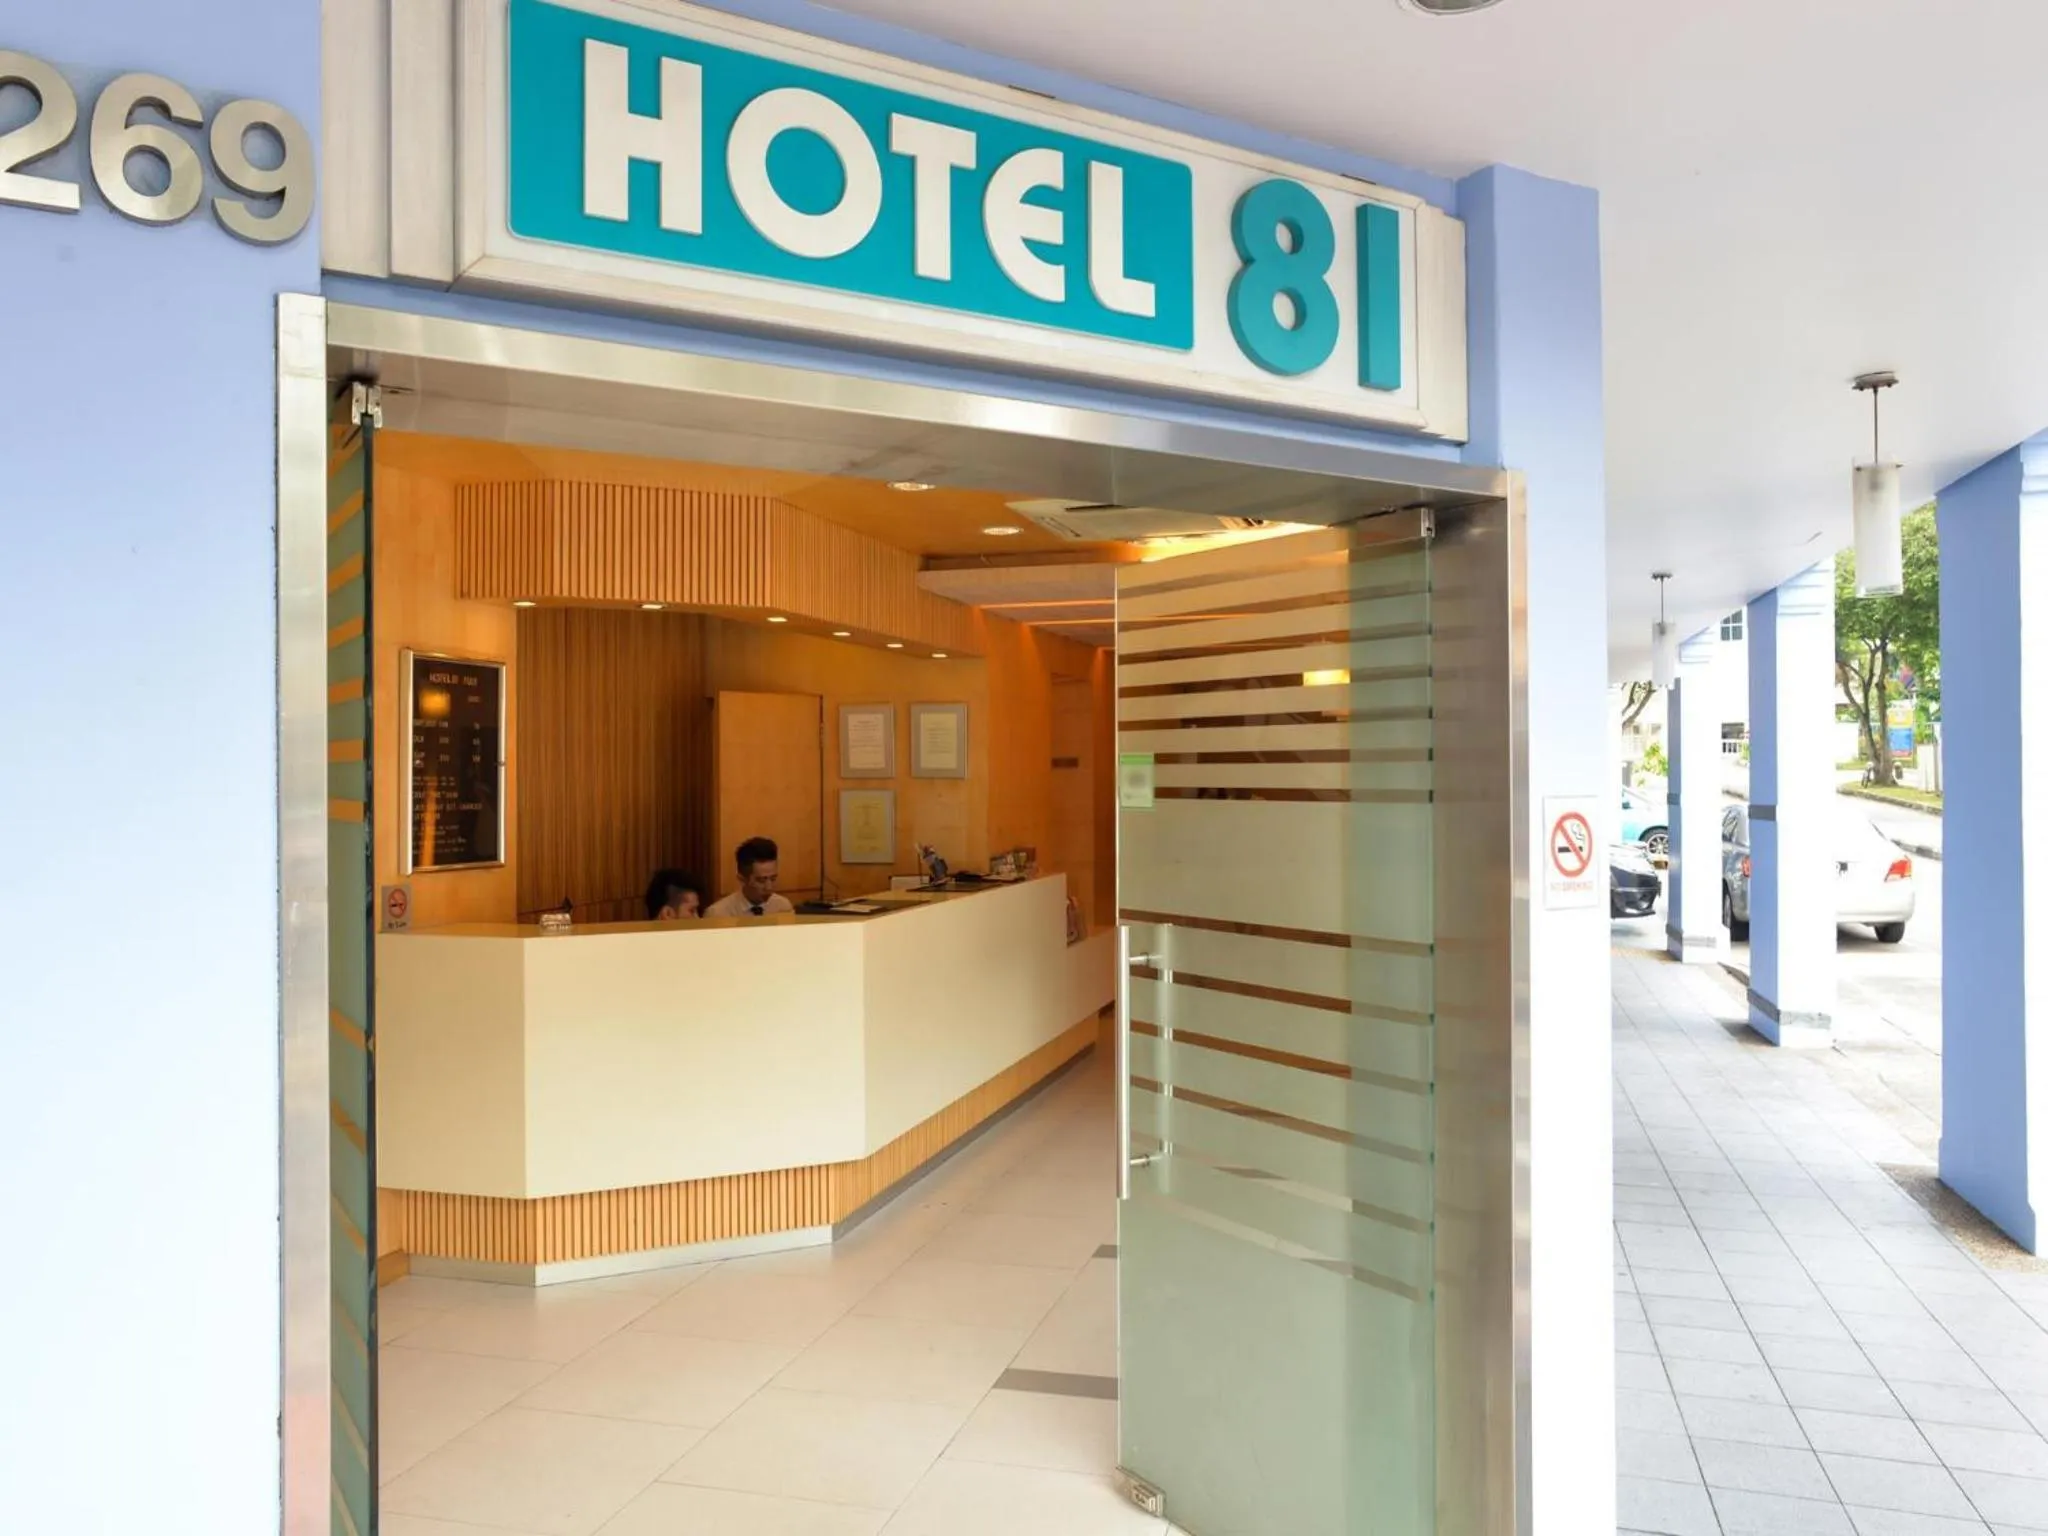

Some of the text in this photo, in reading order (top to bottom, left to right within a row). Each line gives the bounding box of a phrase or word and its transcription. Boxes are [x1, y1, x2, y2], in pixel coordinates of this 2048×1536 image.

[0, 49, 316, 248] 269
[583, 38, 1402, 392] HOTEL 81
